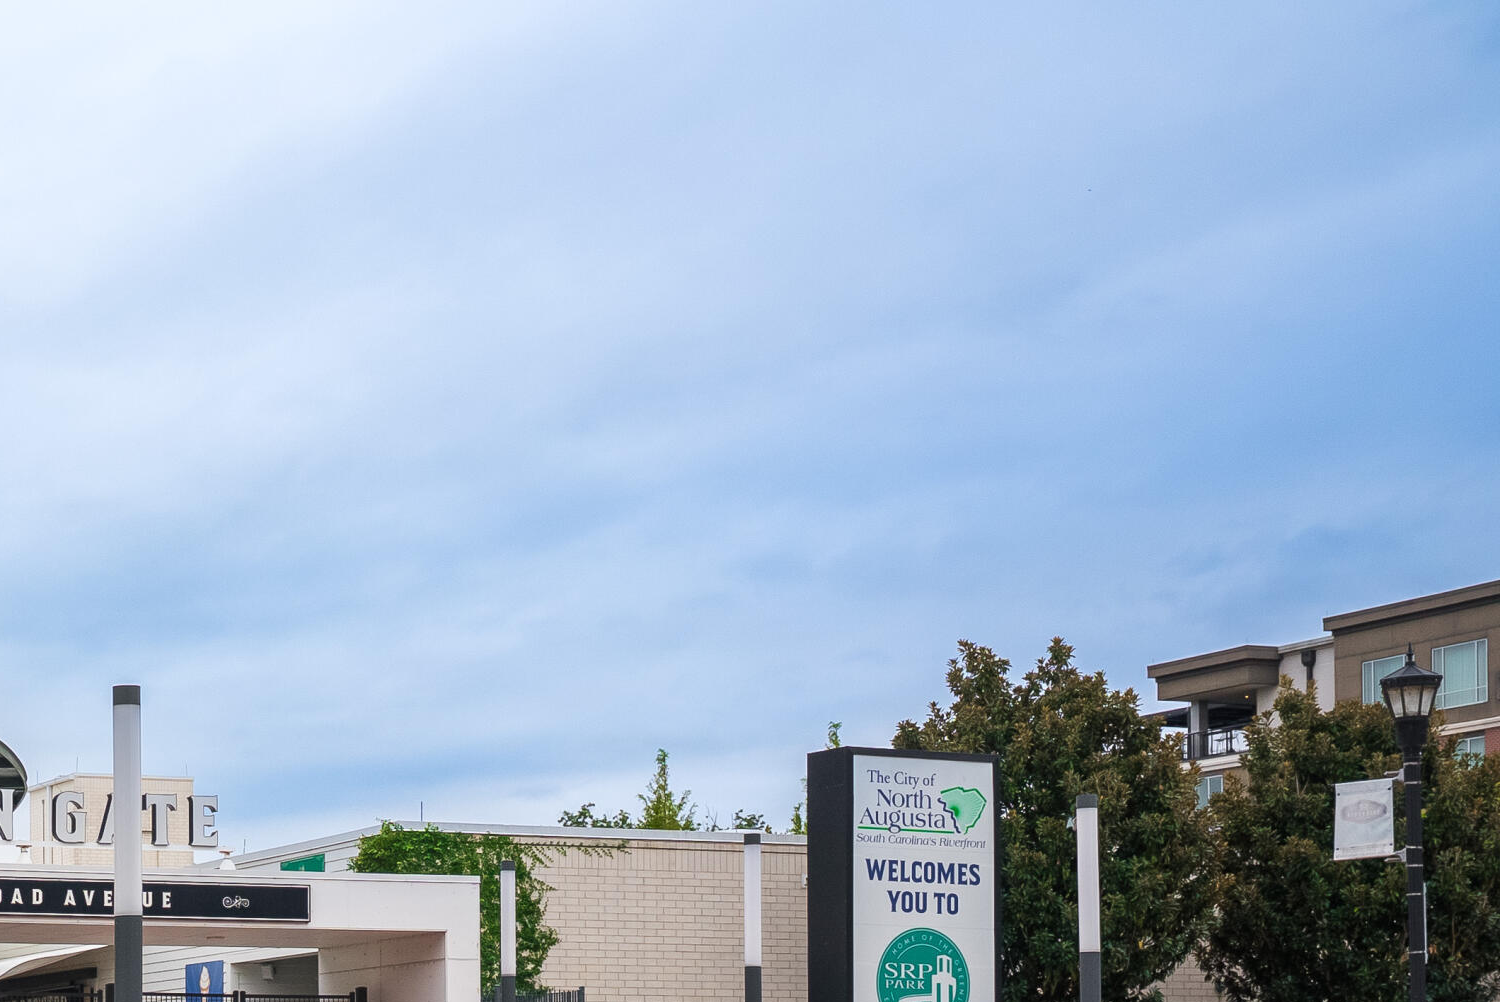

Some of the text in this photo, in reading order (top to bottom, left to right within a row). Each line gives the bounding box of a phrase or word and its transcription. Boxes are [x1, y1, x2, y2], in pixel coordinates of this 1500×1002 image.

[866, 769, 937, 790] The City of
[876, 788, 932, 810] North
[859, 806, 946, 834] Augusta
[856, 832, 987, 850] South Carolina's Riverfront
[864, 858, 981, 886] WELCOMES
[63, 888, 173, 909] AVEUE
[886, 890, 959, 915] YOU TO
[884, 962, 933, 980] SRP
[885, 979, 925, 990] PARK
